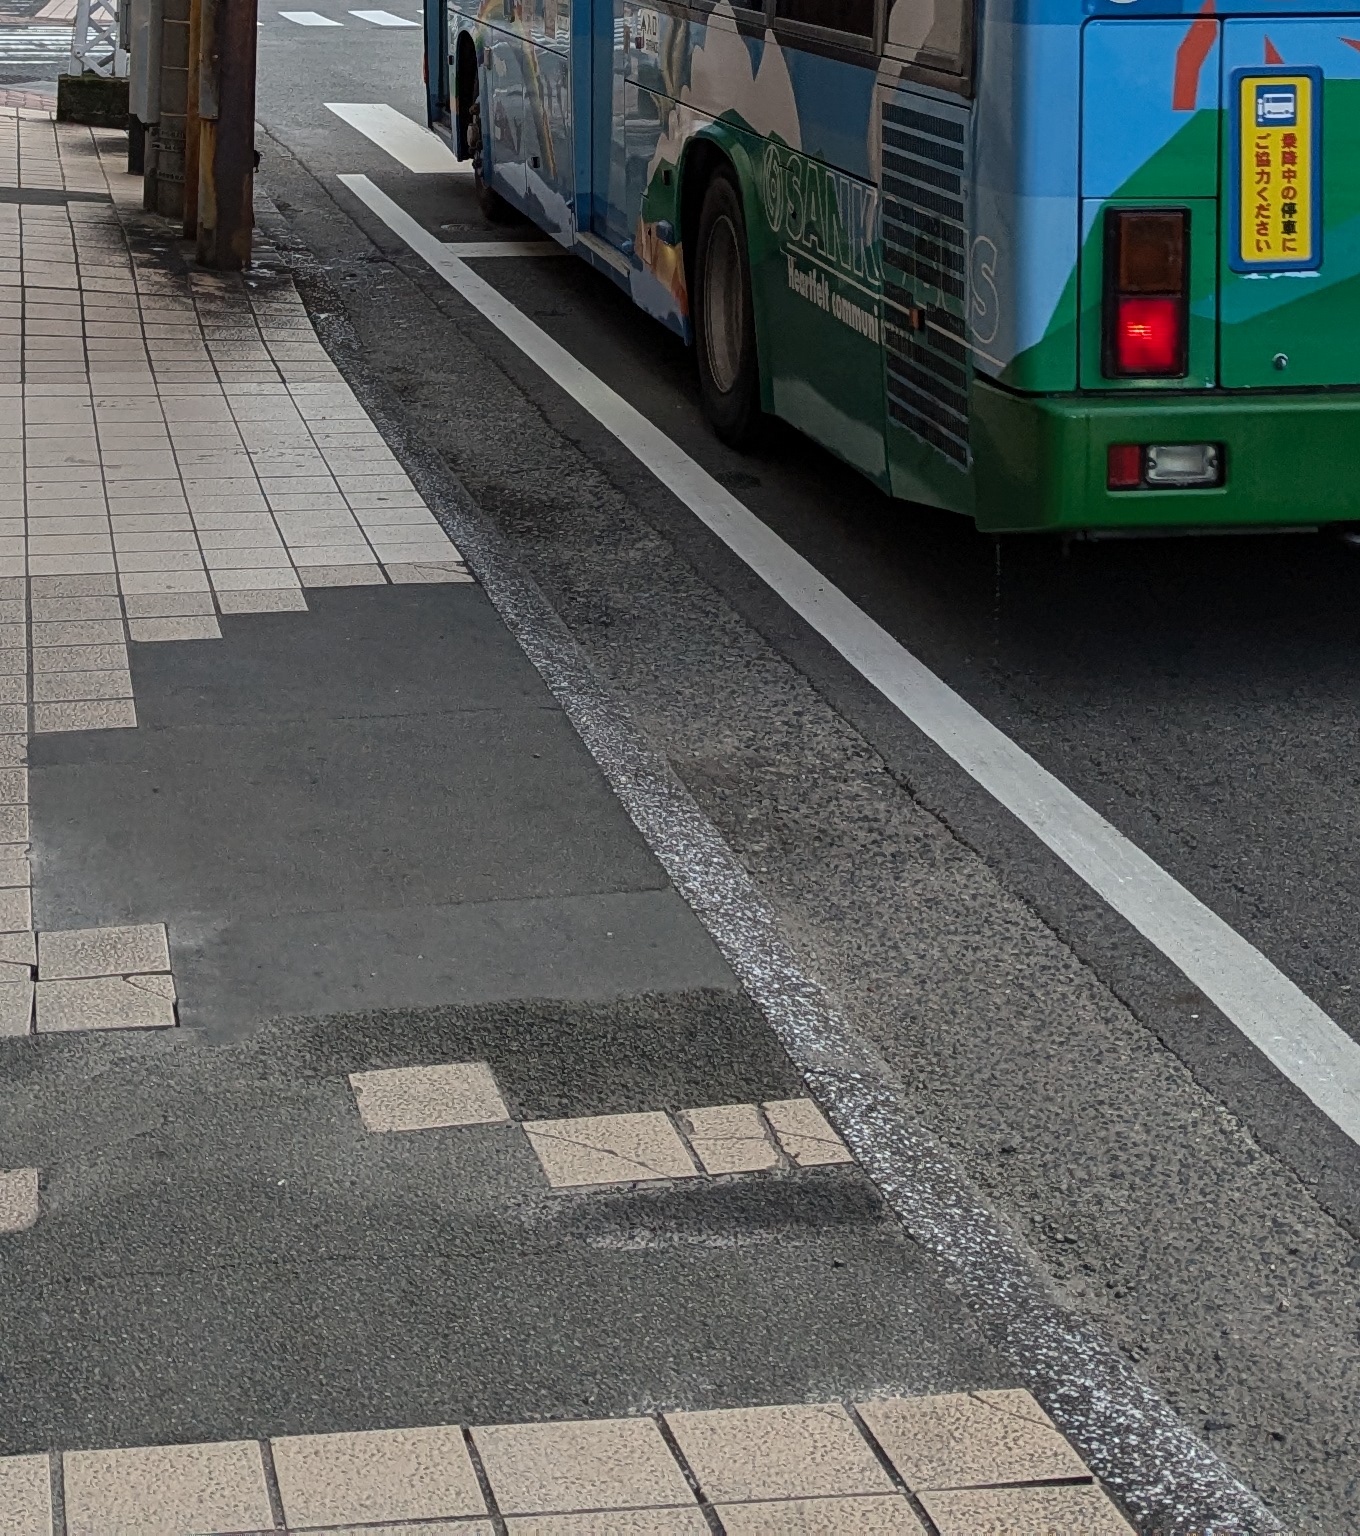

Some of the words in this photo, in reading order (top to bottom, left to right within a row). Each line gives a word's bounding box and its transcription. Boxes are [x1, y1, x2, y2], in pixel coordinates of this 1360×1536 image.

[1254, 132, 1272, 253] ご協力ください
[1280, 132, 1298, 253] 乗降中の停車に
